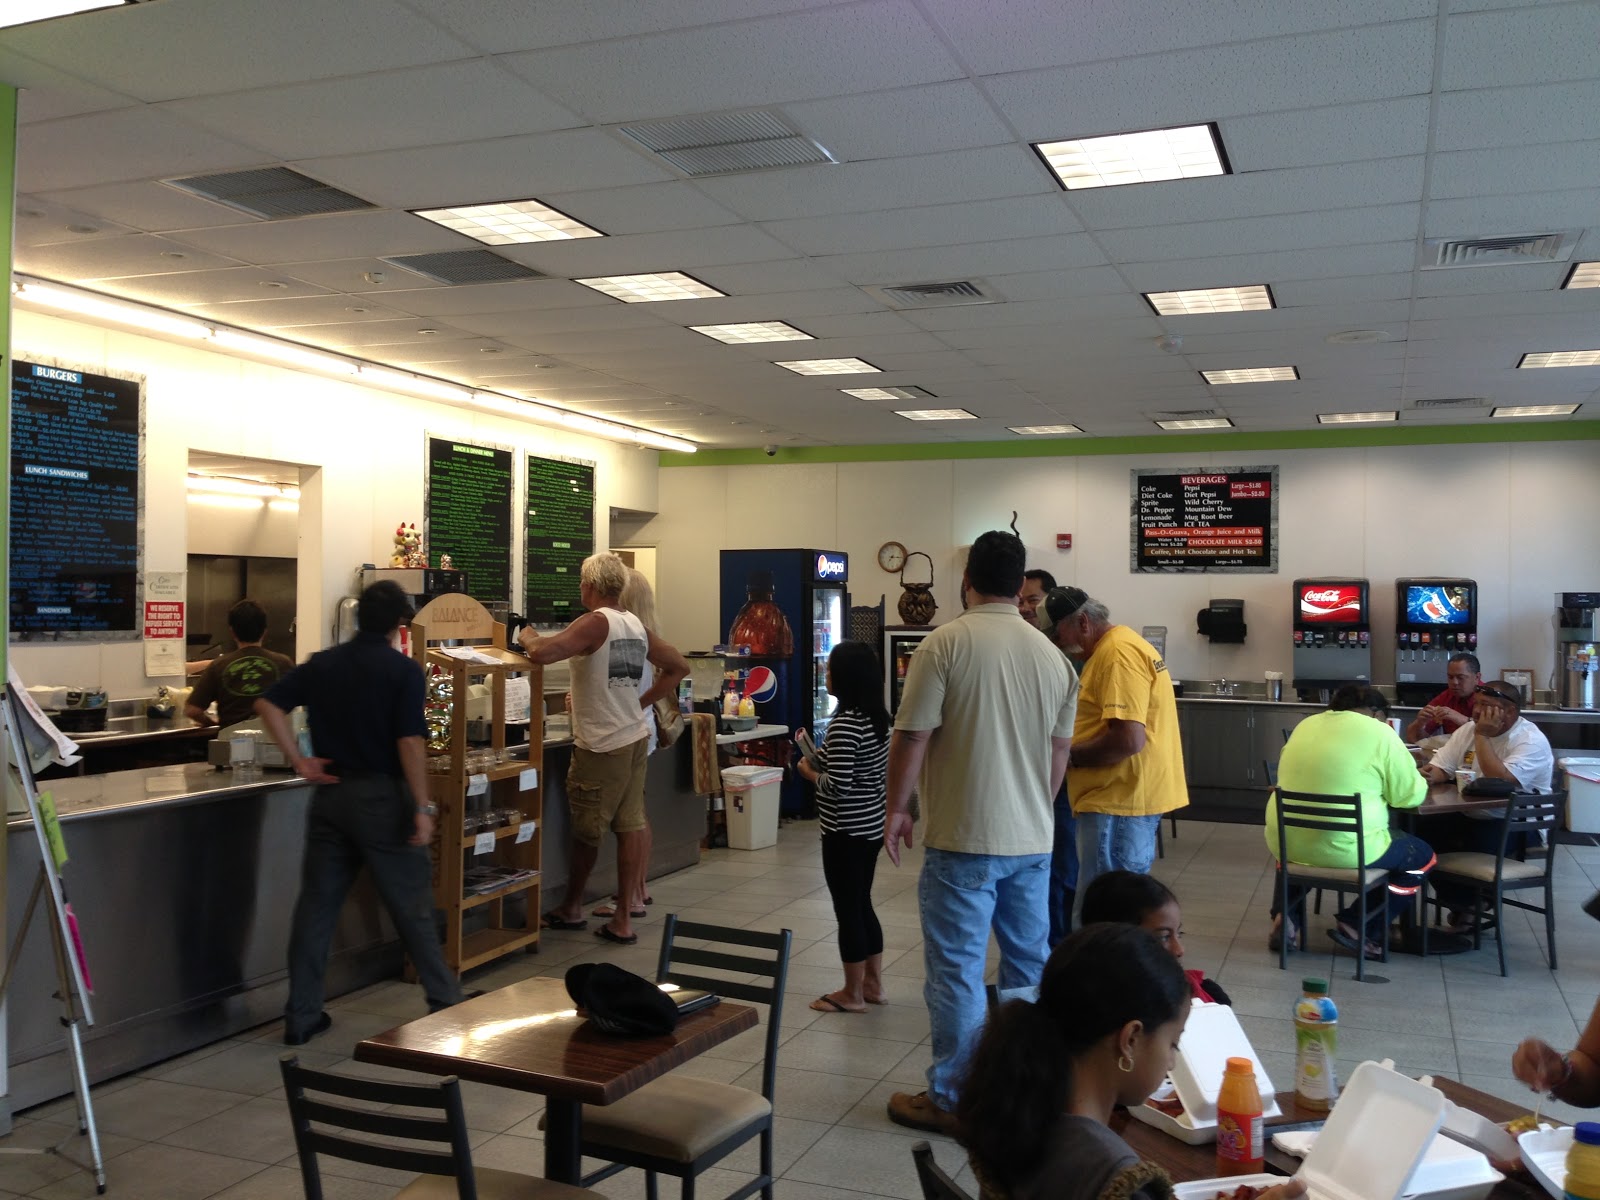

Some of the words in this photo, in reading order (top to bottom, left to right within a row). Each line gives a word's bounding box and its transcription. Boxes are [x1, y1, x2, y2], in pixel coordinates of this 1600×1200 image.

[36, 367, 77, 382] BURGERS
[25, 466, 47, 474] LUNCH
[49, 468, 88, 479] SANDWICHES
[1182, 476, 1226, 484] BEVERAGES
[827, 561, 844, 575] pepsi
[432, 608, 478, 622] BALANCE
